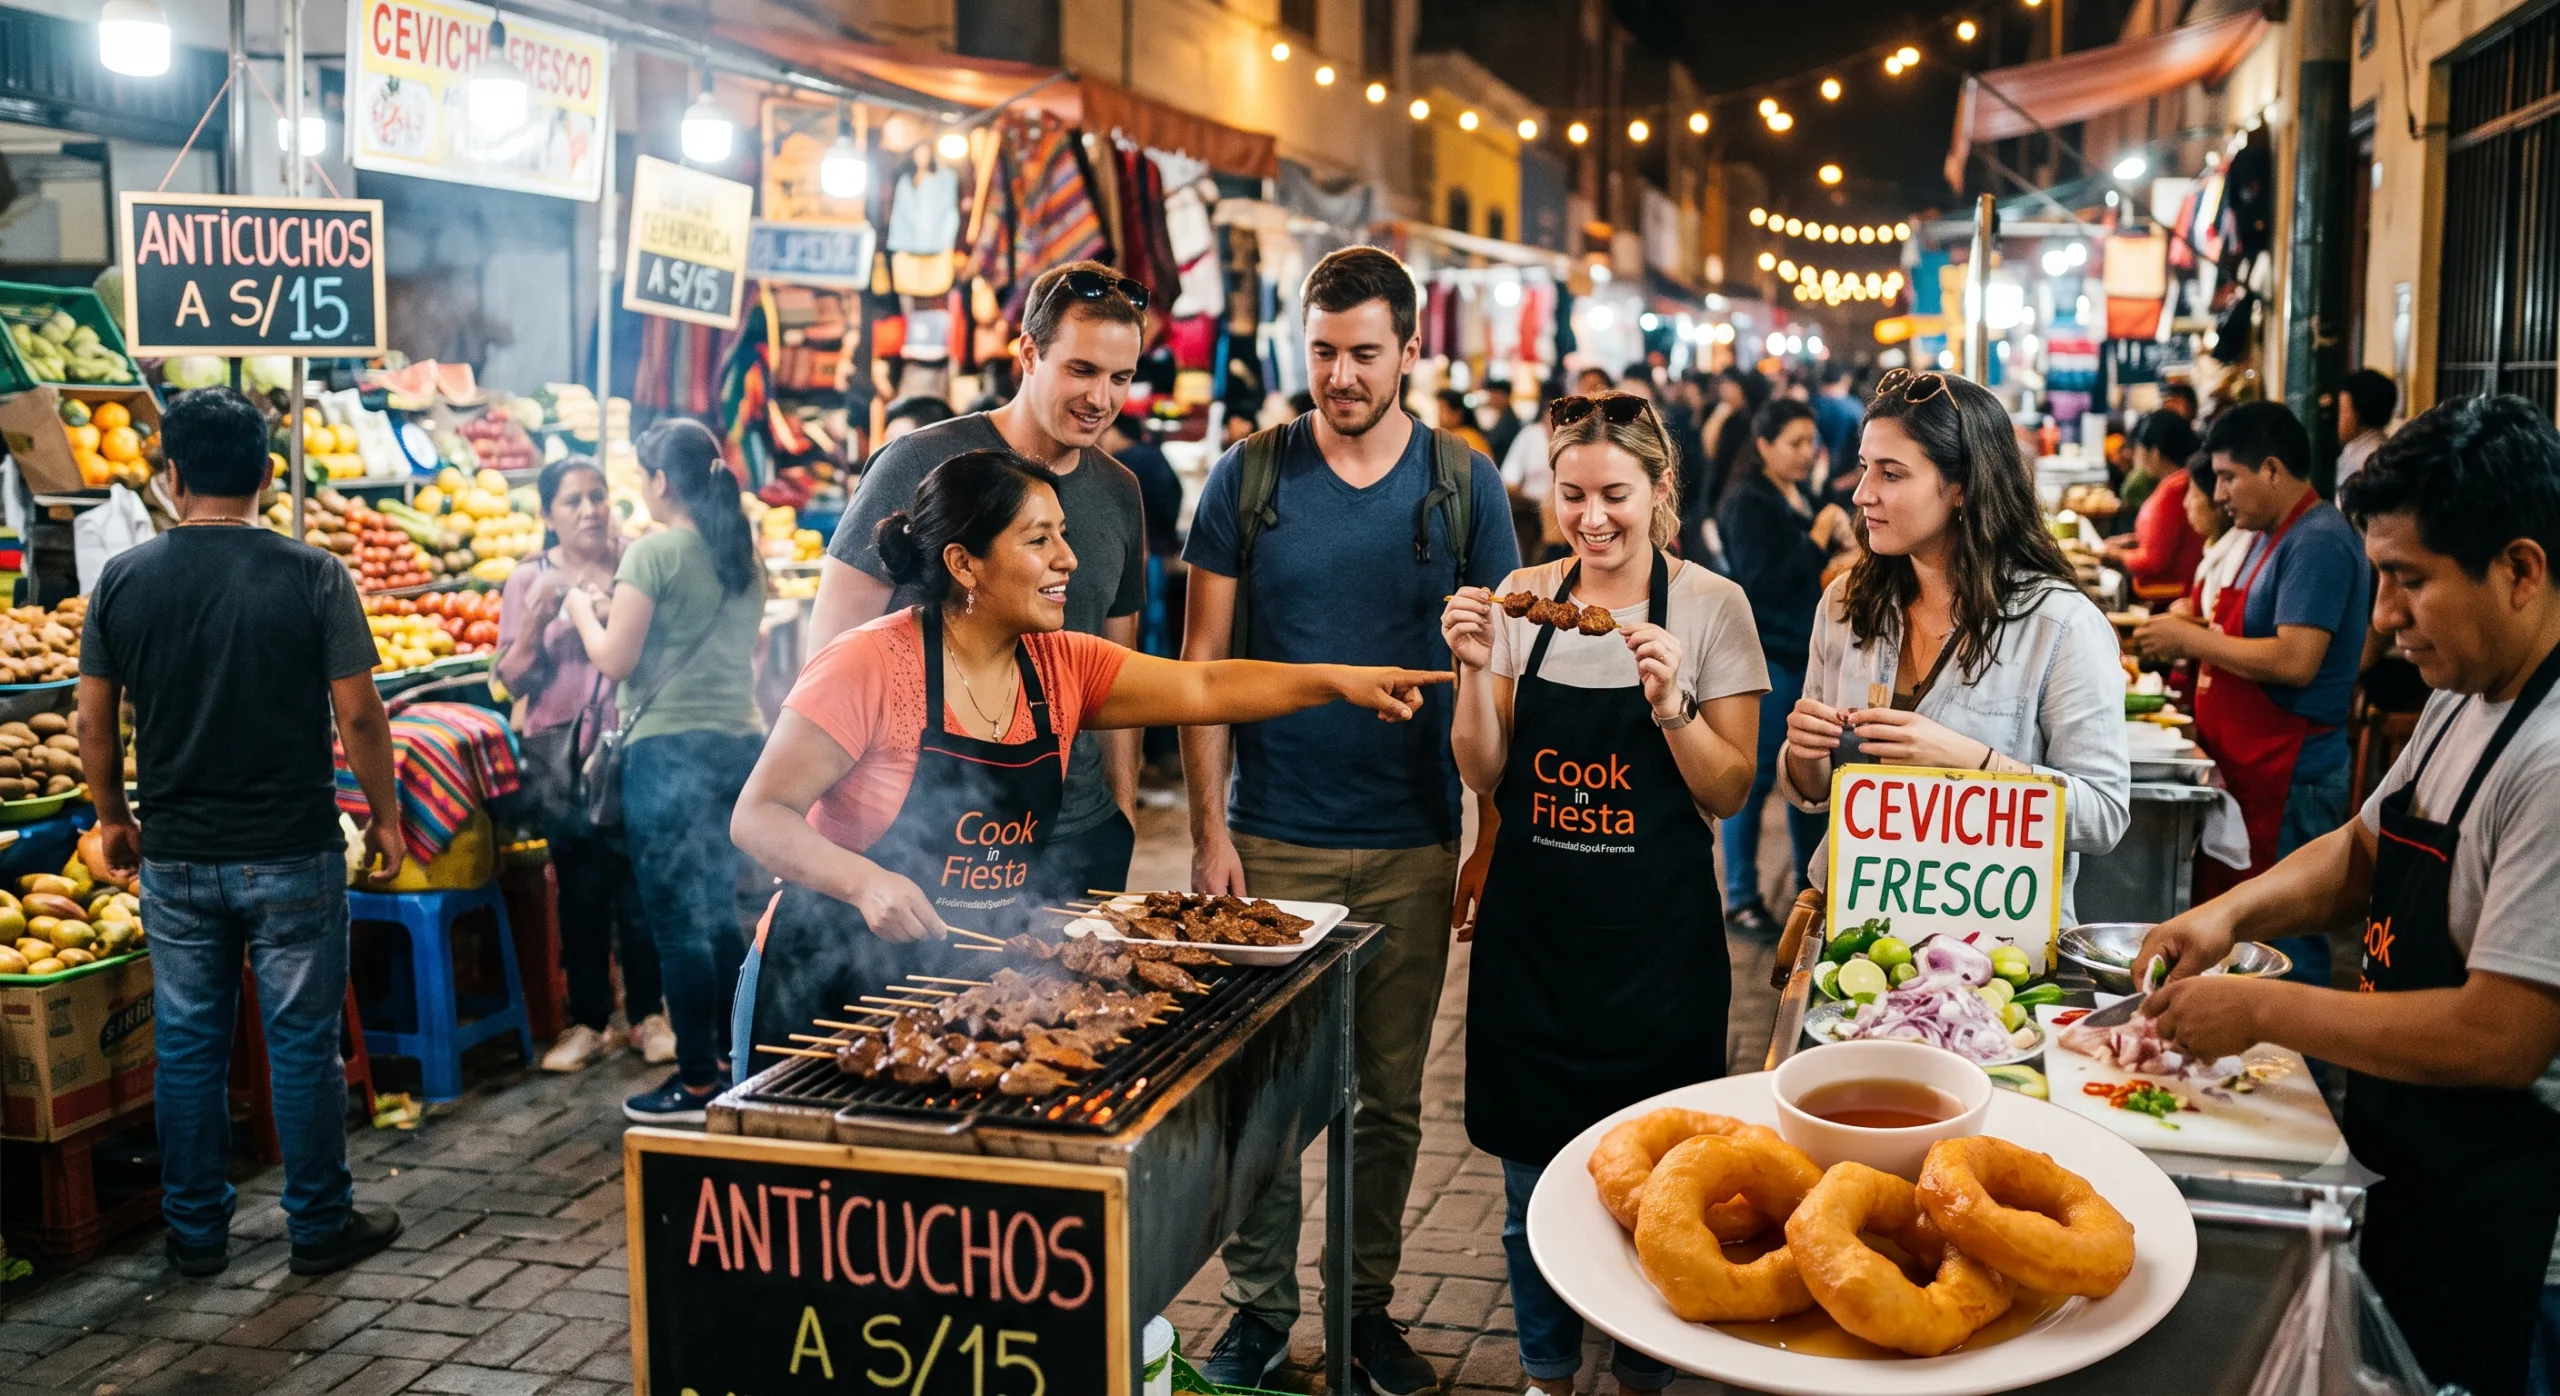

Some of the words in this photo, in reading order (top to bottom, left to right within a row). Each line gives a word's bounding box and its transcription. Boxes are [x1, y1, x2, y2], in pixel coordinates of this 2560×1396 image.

[647, 257, 666, 296] A
[175, 280, 211, 328] A
[229, 275, 350, 341] S/15
[1534, 748, 1632, 790] Cook
[1533, 792, 1635, 835] Fiesta
[1575, 788, 1589, 804] in
[1844, 779, 2048, 848] CEVICHE
[955, 811, 1038, 845] Cook
[941, 855, 1027, 890] Fiesta
[987, 847, 1000, 861] in
[1847, 856, 2038, 921] FRESCO
[789, 1306, 835, 1380] A
[862, 1314, 1047, 1396] S/15
